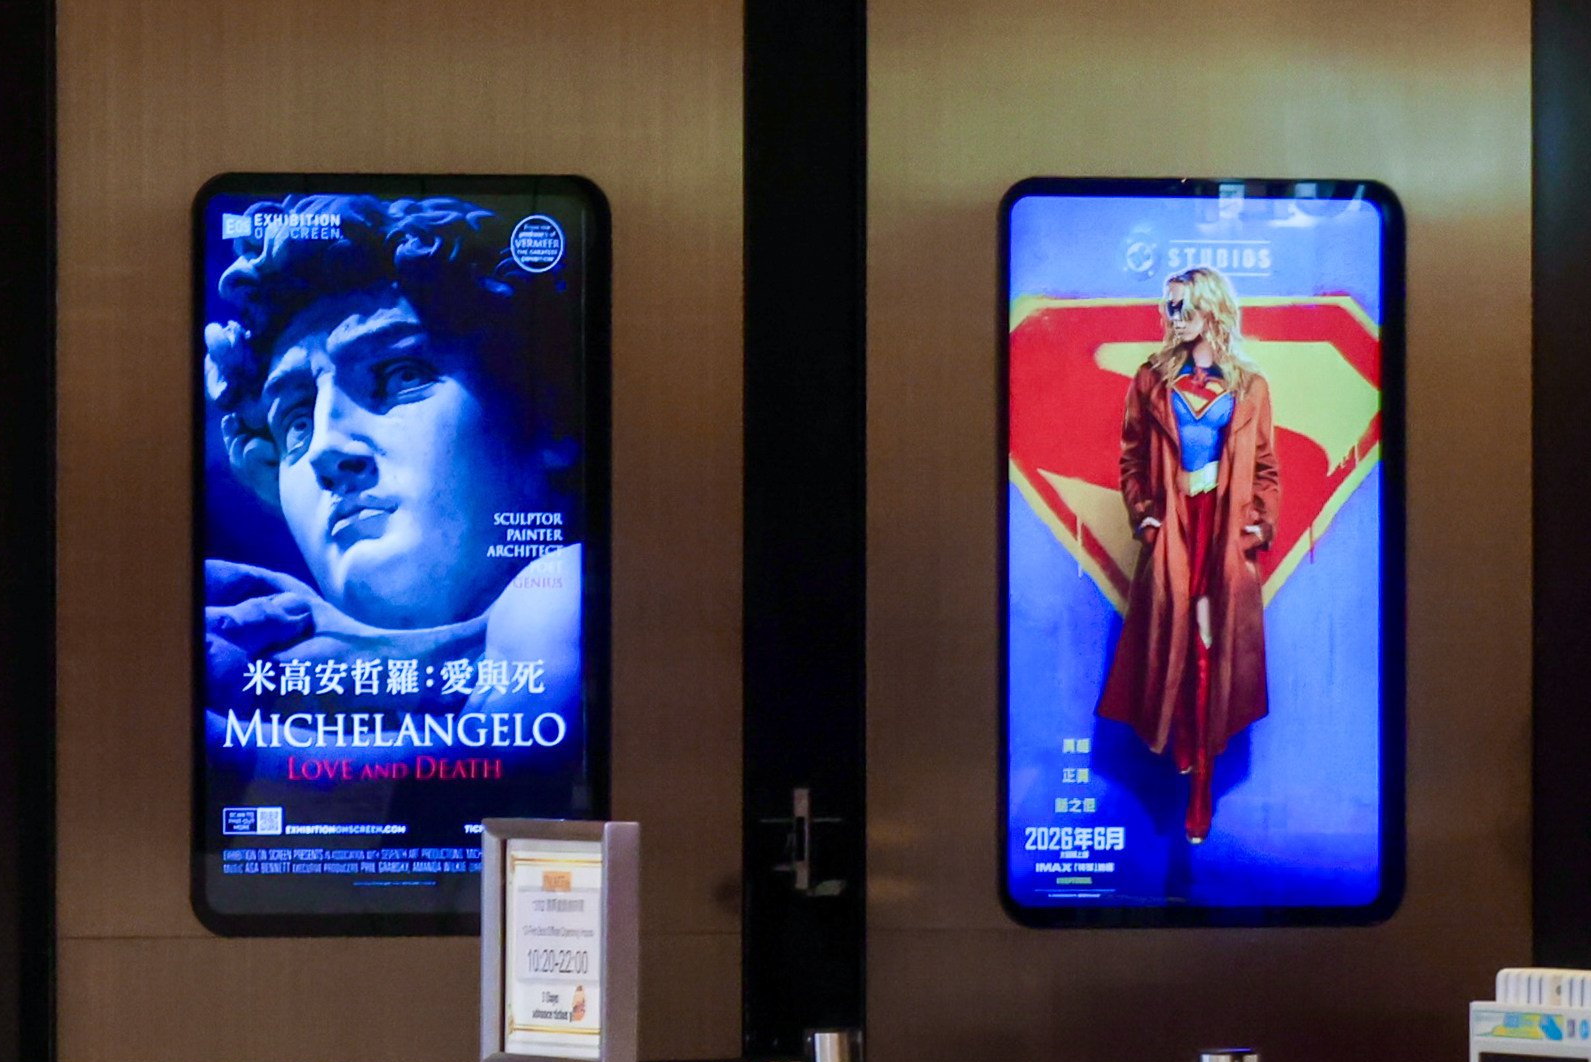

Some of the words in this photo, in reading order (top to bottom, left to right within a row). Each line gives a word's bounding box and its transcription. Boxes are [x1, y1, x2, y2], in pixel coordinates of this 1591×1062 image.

[254, 213, 341, 227] EXHIBITION
[1168, 248, 1271, 269] STUDIOS
[493, 512, 563, 526] SCULPTOR
[506, 528, 564, 541] PAINTER
[242, 658, 545, 696] 米高安哲羅：愛與死
[222, 708, 567, 748] MICHELANGELO
[287, 756, 352, 780] LOVE
[361, 763, 407, 780] AND
[415, 755, 502, 780] DEATH
[285, 825, 406, 835] EXHIBITIONONSCREEN.COM
[1025, 826, 1125, 850] 2026年6月
[1035, 862, 1072, 873] IMAX
